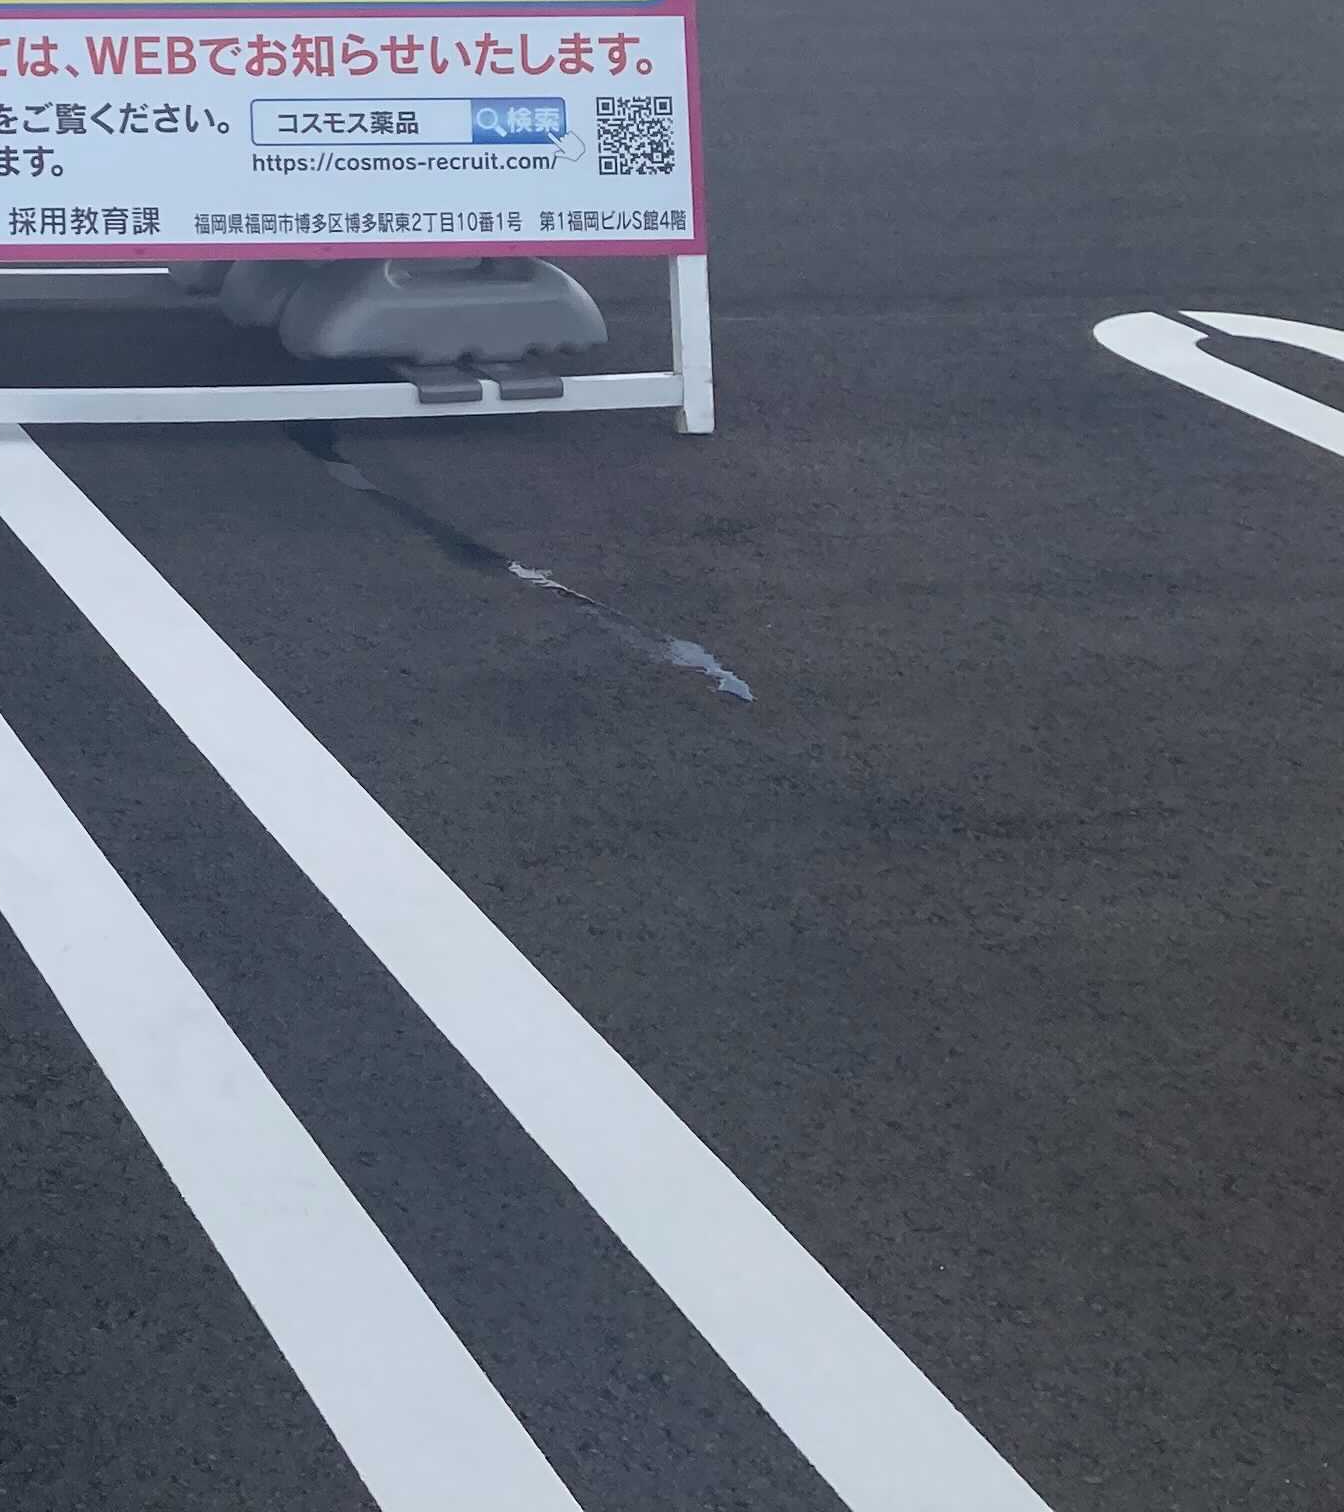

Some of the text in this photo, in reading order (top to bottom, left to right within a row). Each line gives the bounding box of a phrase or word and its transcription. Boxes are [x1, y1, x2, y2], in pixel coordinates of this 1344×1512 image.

[277, 110, 420, 136] コスモス薬品
[506, 106, 561, 134] 検索
[251, 152, 557, 175] https://cosmos-recruit.com/
[8, 206, 161, 236] 採用教育課
